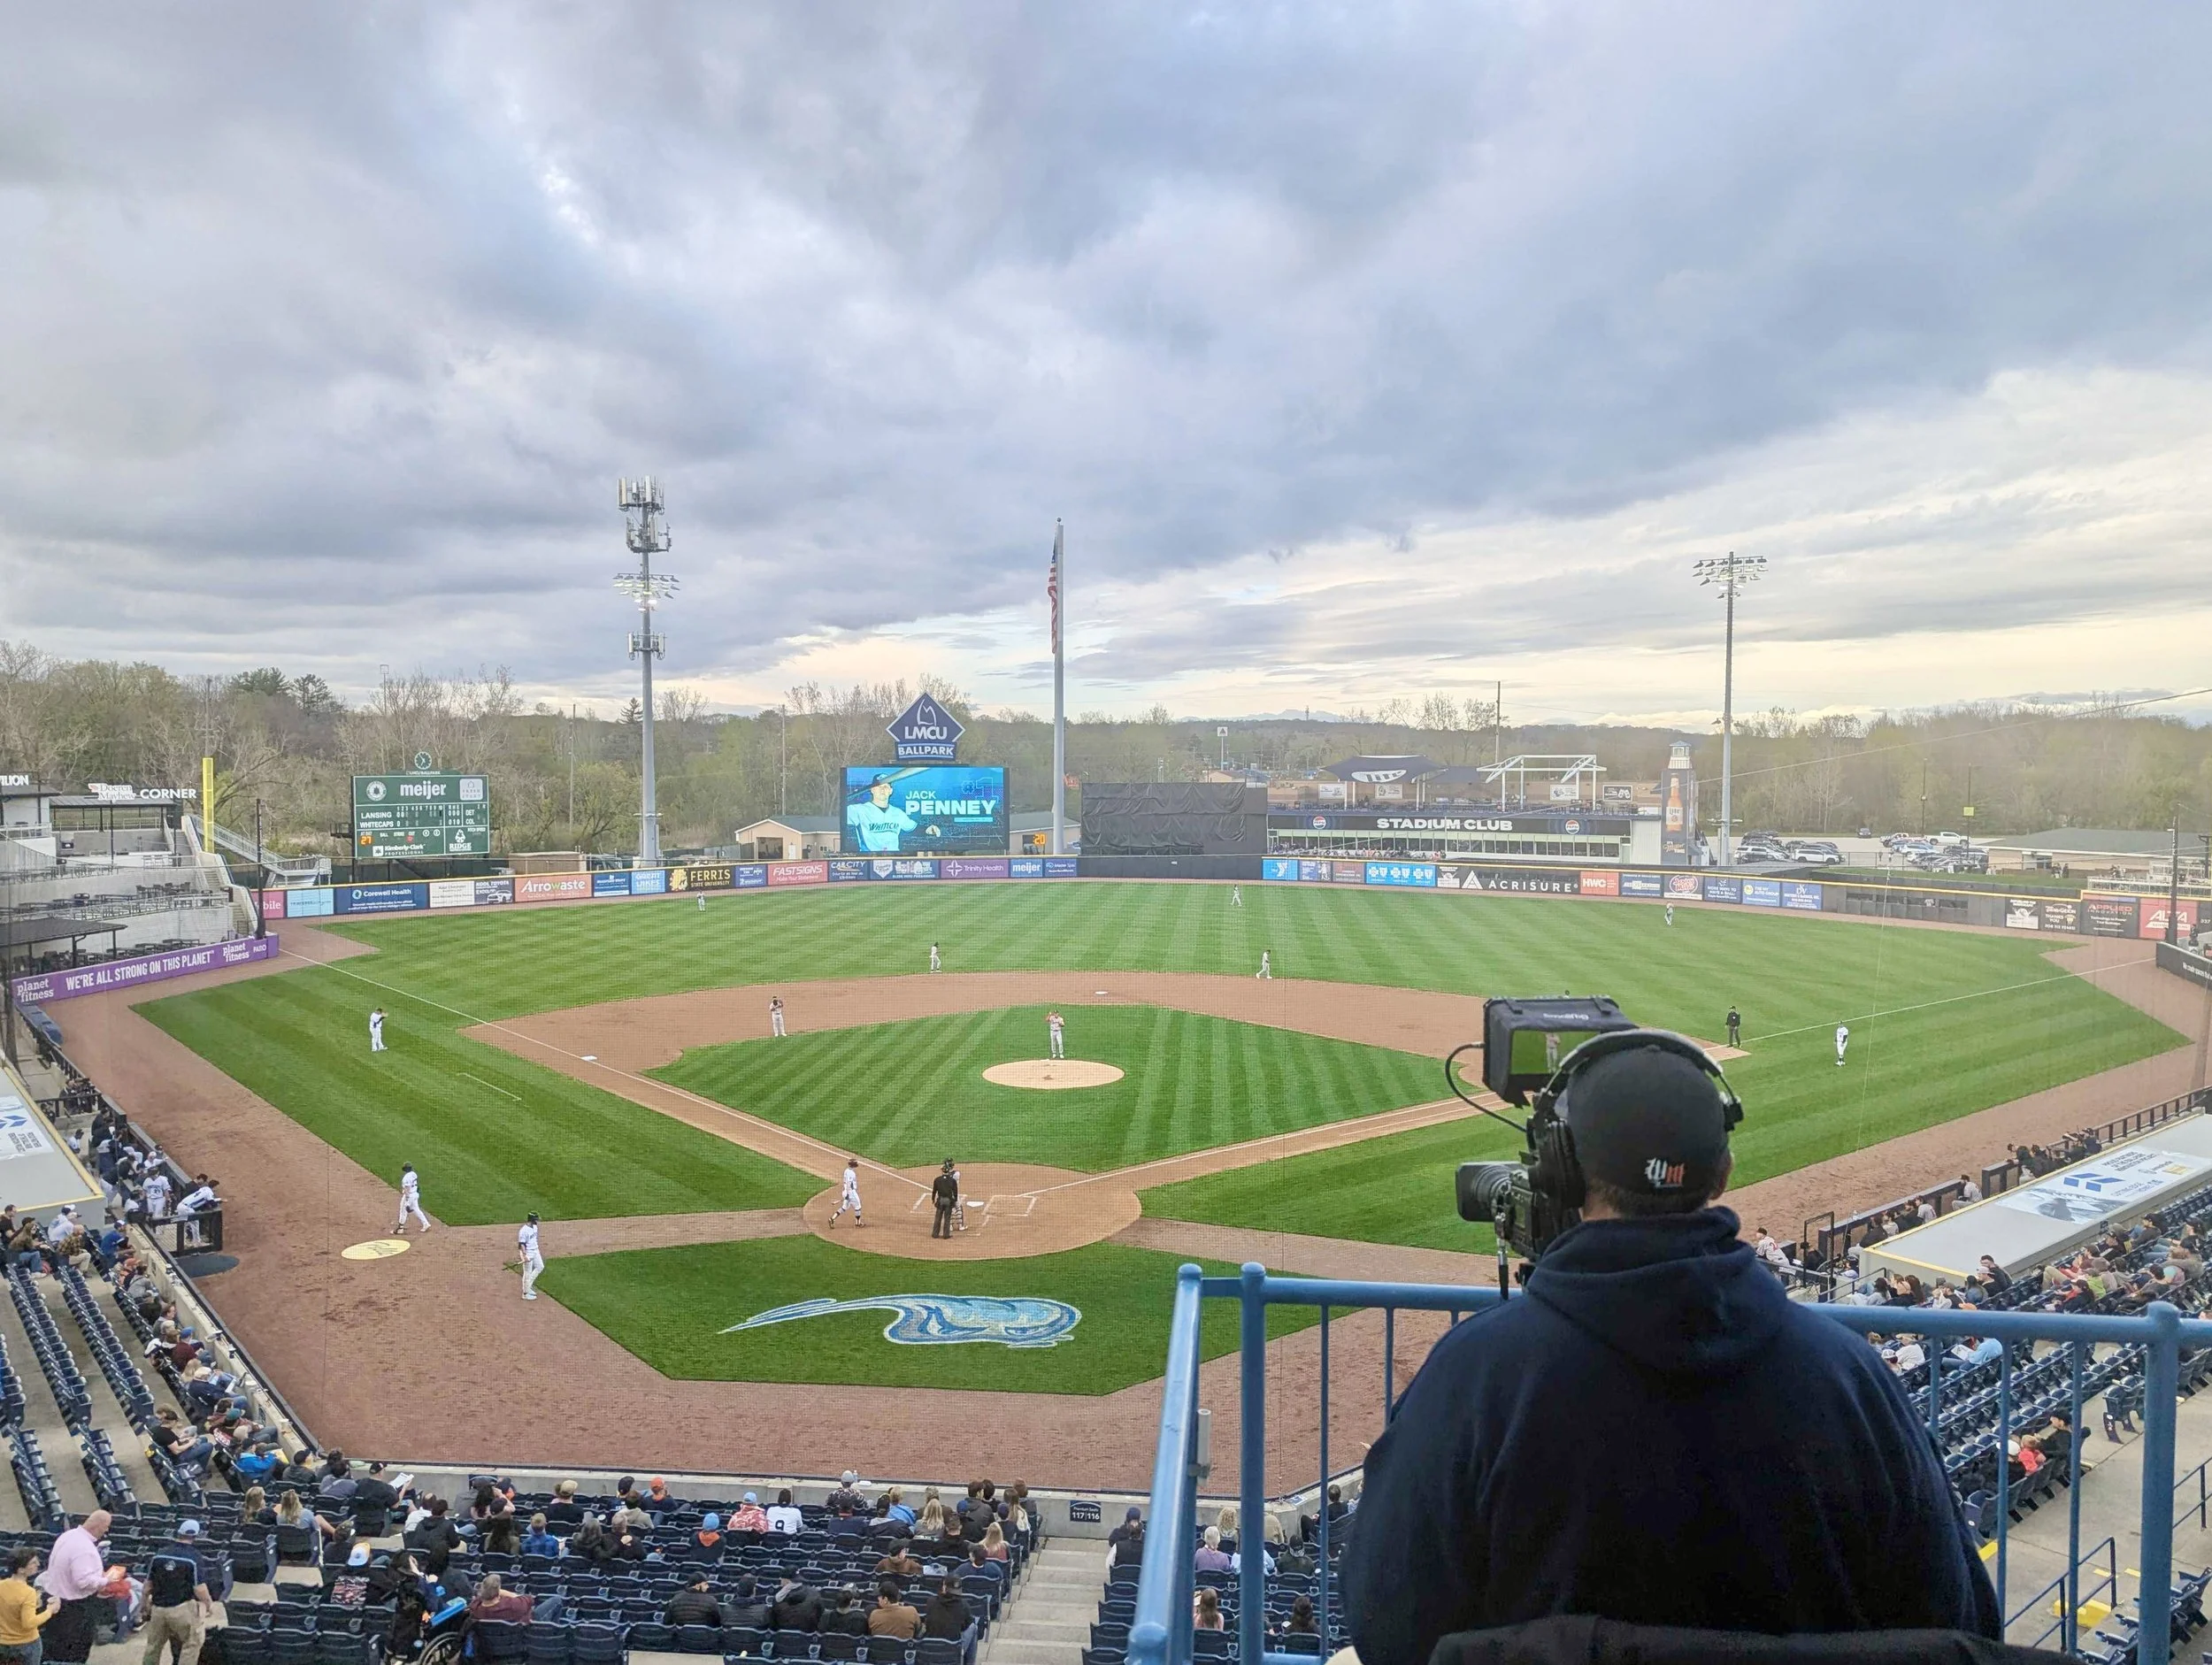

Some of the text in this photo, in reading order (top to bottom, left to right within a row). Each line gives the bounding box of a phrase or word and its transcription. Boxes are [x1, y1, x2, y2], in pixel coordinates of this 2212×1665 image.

[904, 726, 947, 740] LMCU
[898, 747, 955, 756] BALLPARK
[141, 788, 197, 799] CORNER
[400, 780, 446, 800] meijer
[905, 791, 936, 800] JACK
[905, 801, 996, 816] PENNEY
[1377, 818, 1512, 831] STADIUM CLUB
[360, 836, 372, 845] 27
[1033, 834, 1045, 844] 20
[773, 865, 823, 876] FASTSIGNS
[1012, 863, 1041, 873] meijer
[690, 869, 731, 881] FERRIS
[520, 879, 586, 893] Arrowaste
[1582, 879, 1606, 888] HWC
[223, 942, 246, 956] planet
[226, 952, 250, 963] fitness
[65, 952, 211, 991] WE'RE ALL STRONG ON THIS PLANET
[17, 978, 49, 996] planet
[20, 988, 54, 1003] fitness
